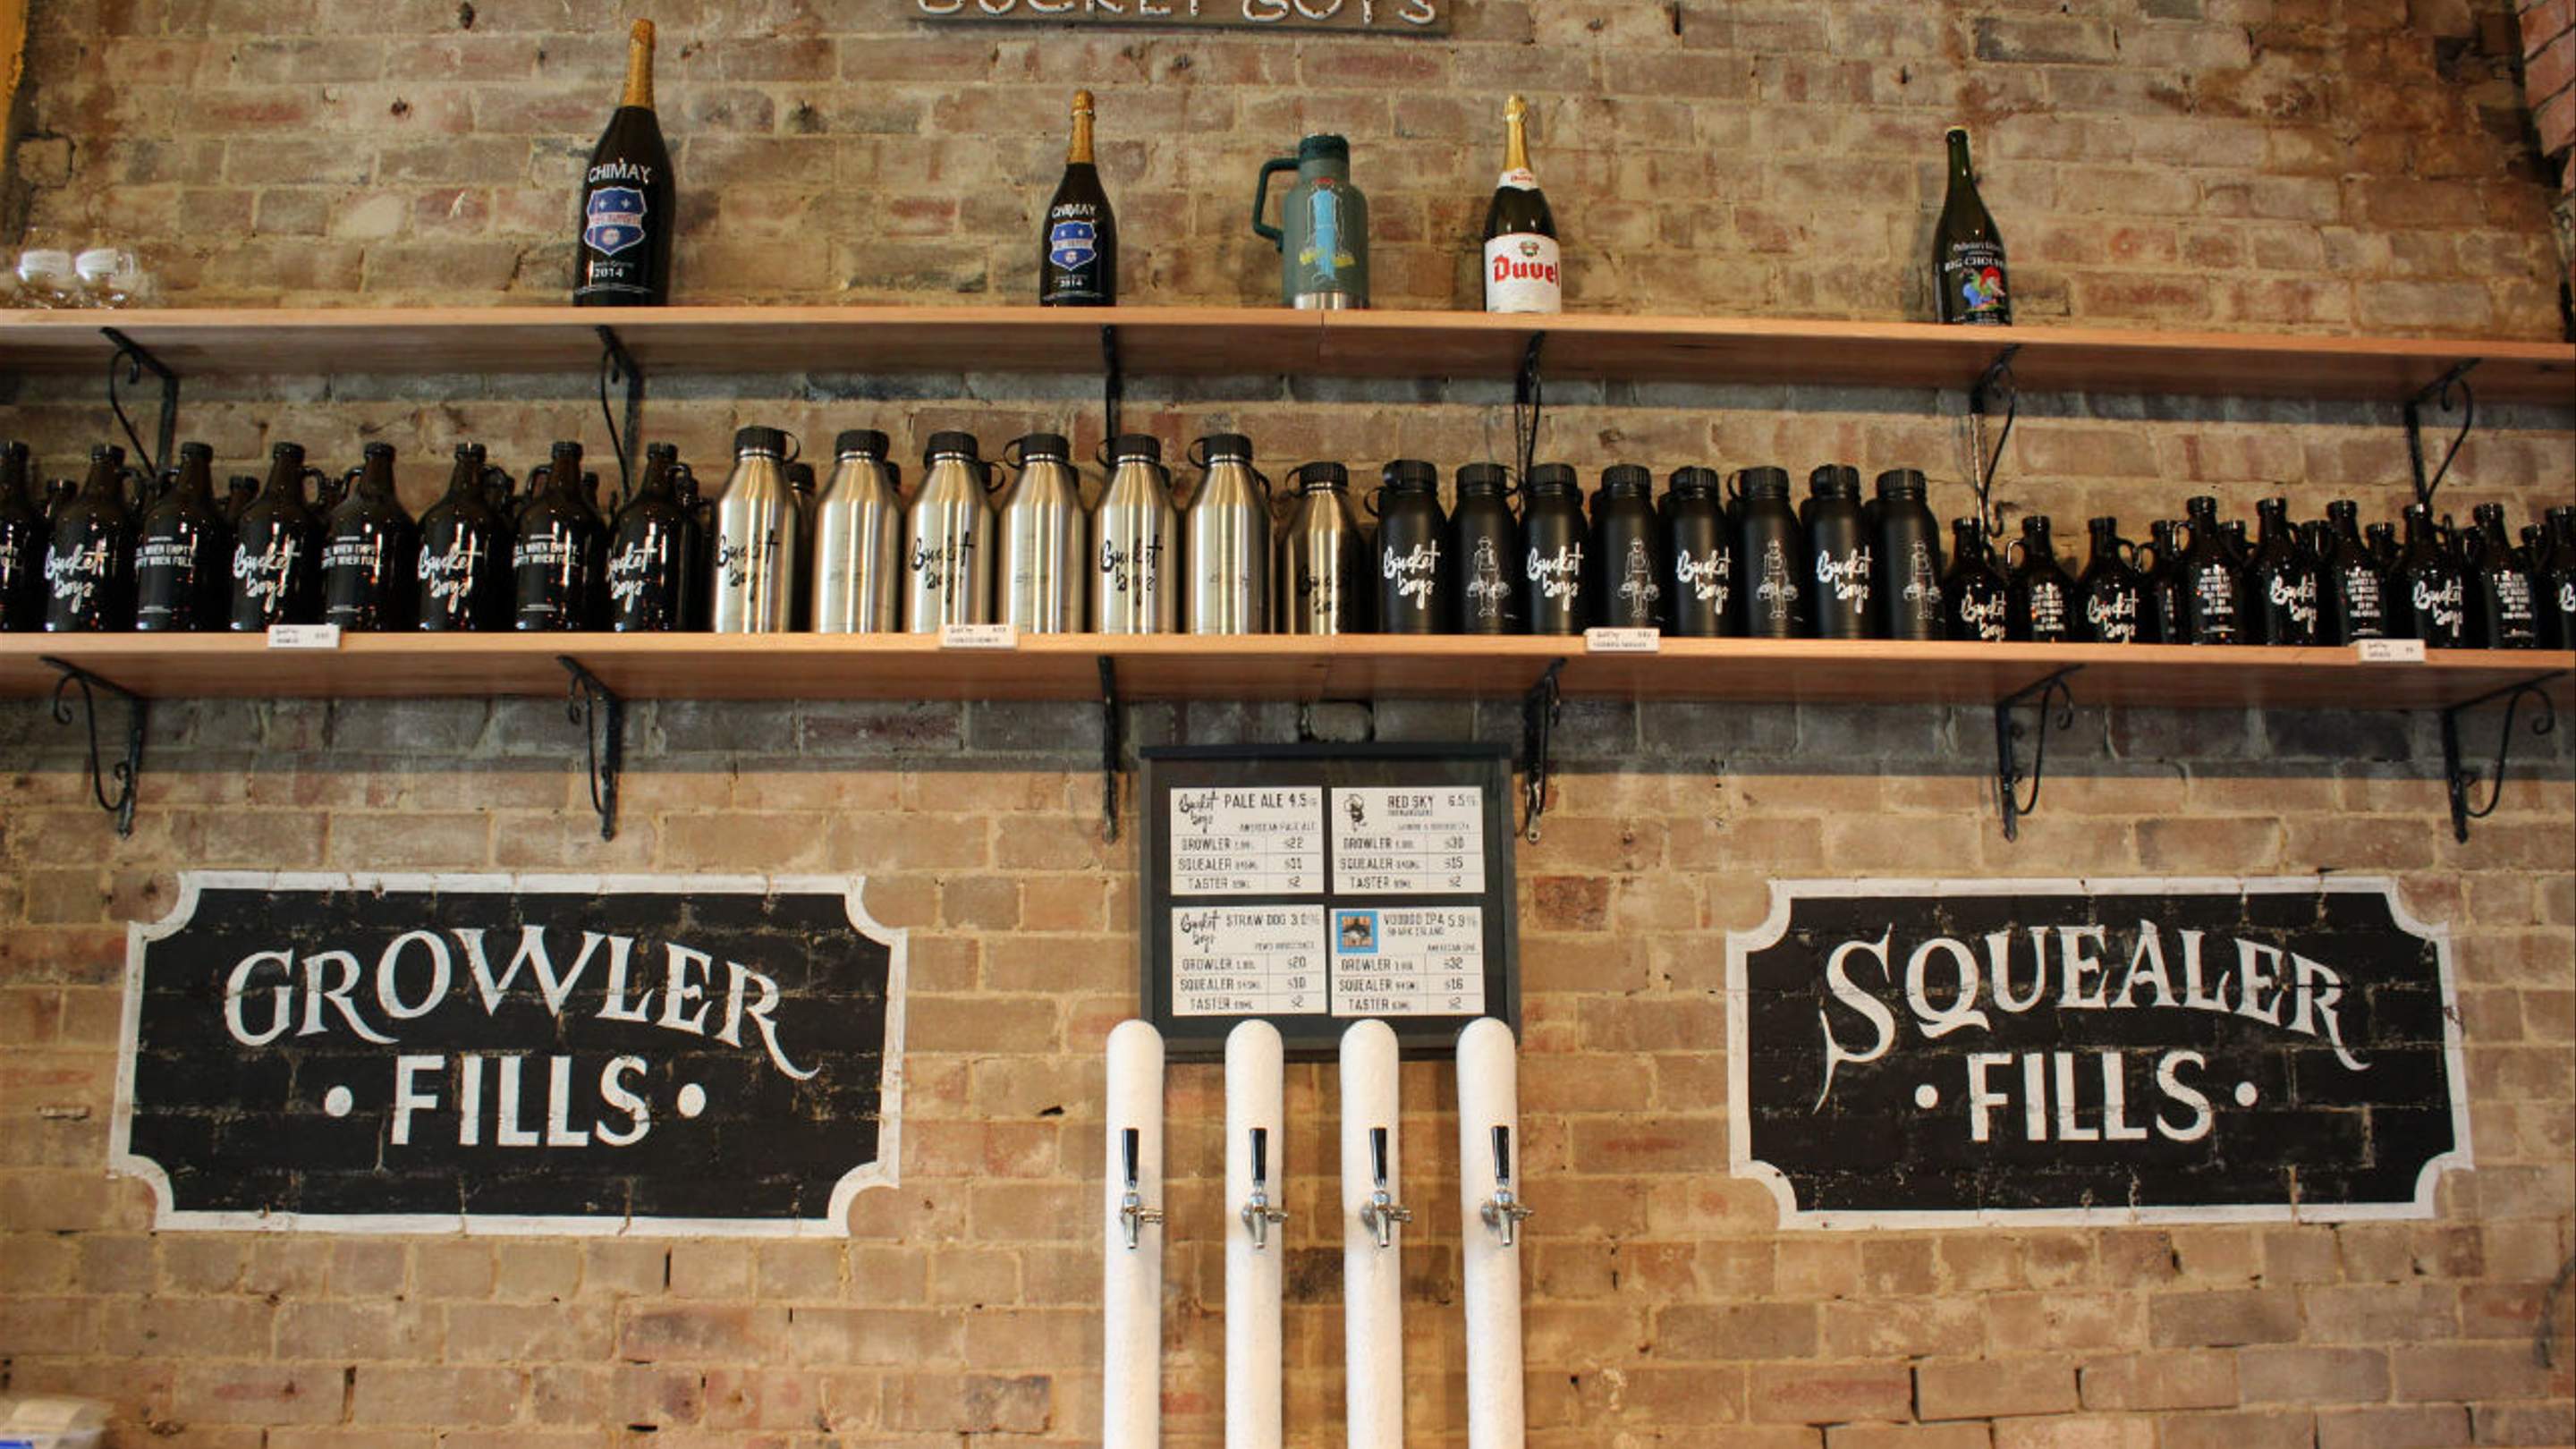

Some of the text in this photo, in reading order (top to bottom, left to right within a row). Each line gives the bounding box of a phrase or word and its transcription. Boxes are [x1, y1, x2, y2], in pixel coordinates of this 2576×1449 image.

[589, 163, 651, 184] CHIMAY
[594, 267, 624, 278] 2014
[1493, 254, 1560, 287] Duvel
[1224, 793, 1256, 809] PALE
[1261, 793, 1284, 809] ALE
[1387, 795, 1409, 809] RED
[1411, 795, 1434, 809] SKY
[1182, 838, 1230, 850] GROWLER
[1284, 836, 1304, 849] $22
[1343, 838, 1392, 850] GROWLER
[1178, 858, 1232, 871] SQUEALER
[1340, 858, 1393, 870] SQUEALER
[1445, 856, 1463, 869] $15
[1189, 877, 1228, 889] TASTER
[1351, 877, 1389, 889] TASTER
[1226, 914, 1262, 928] STRAW
[1267, 914, 1286, 926] DOG
[1426, 913, 1445, 926] IPA
[1182, 959, 1233, 970] GROWLER
[1288, 957, 1307, 970] $20
[1341, 959, 1391, 971] GROWLER
[1180, 979, 1233, 991] SQUEALER
[1339, 979, 1393, 992] SQUEALER
[1445, 978, 1463, 990] $16
[224, 925, 822, 1080] GROWLER
[1191, 998, 1230, 1010] TASTER
[1349, 999, 1389, 1011] TASTER
[1813, 919, 2372, 1115] SQUEALER
[391, 1055, 651, 1147] FILLS
[1967, 1050, 2215, 1142] FILLS
